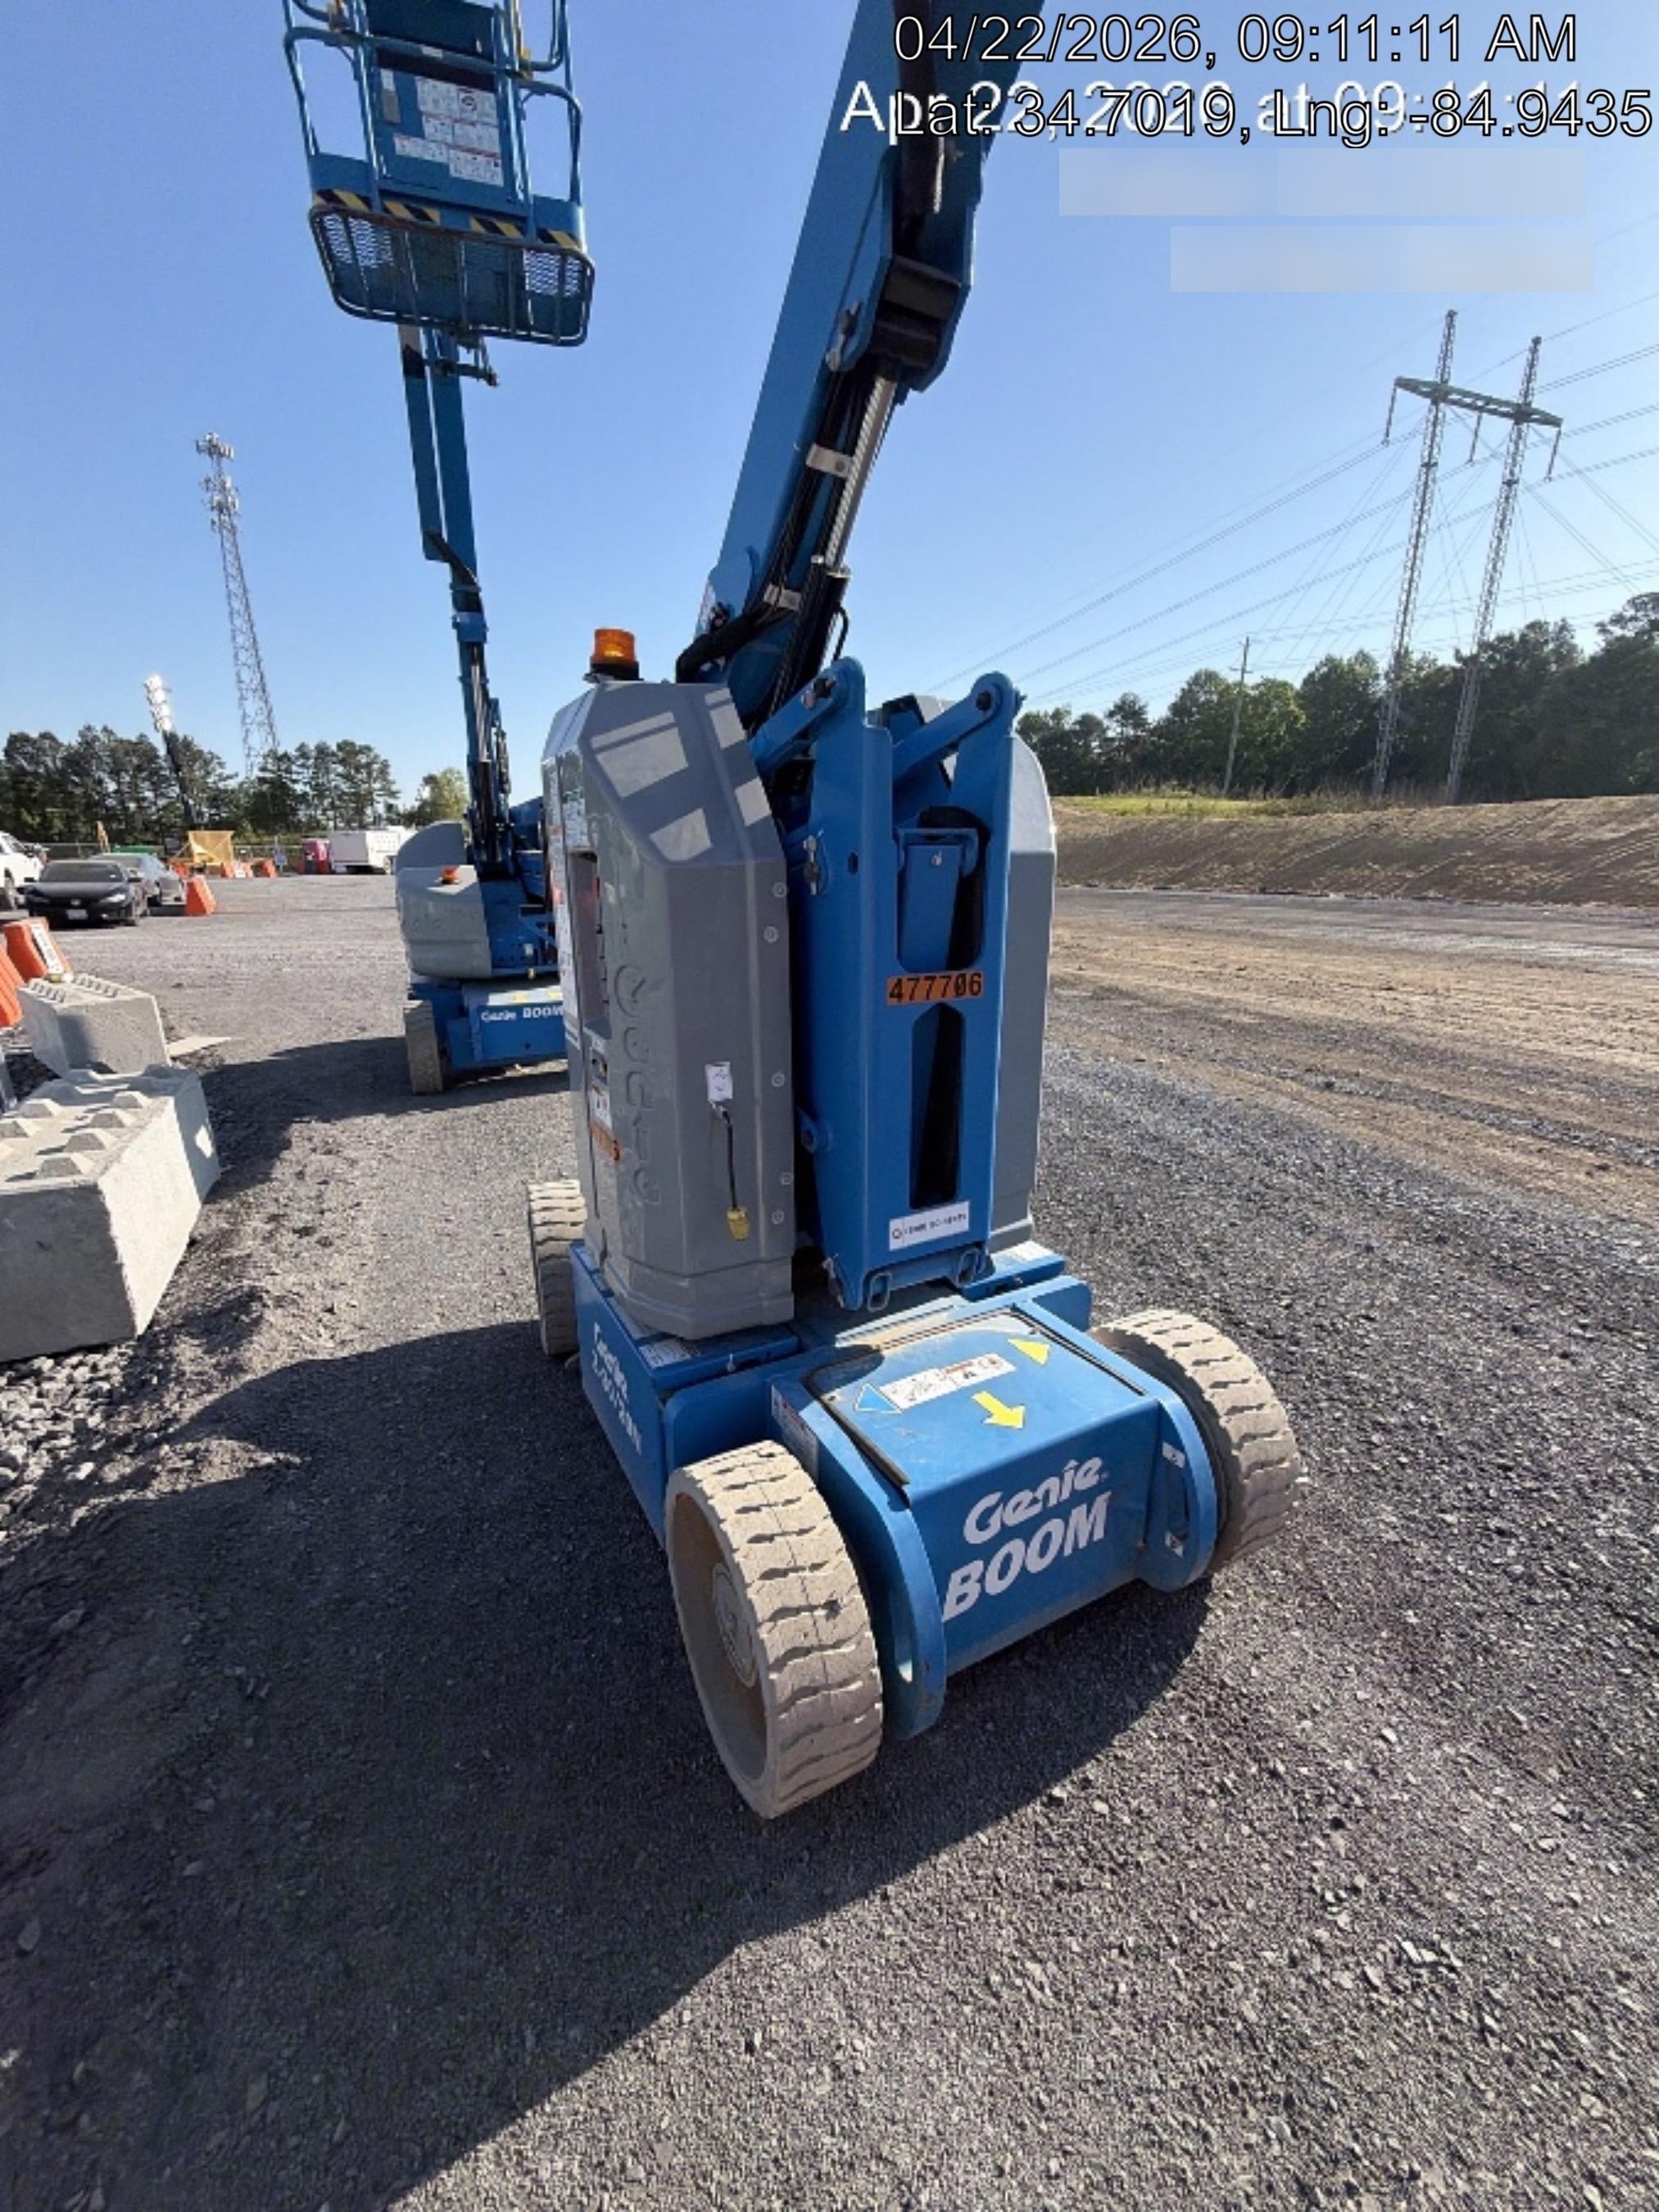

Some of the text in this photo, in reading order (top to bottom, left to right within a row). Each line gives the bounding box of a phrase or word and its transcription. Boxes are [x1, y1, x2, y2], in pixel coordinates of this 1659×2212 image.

[889, 972, 981, 1003] 477706
[963, 1457, 1103, 1544] Genie
[943, 1491, 1112, 1623] BOOM
